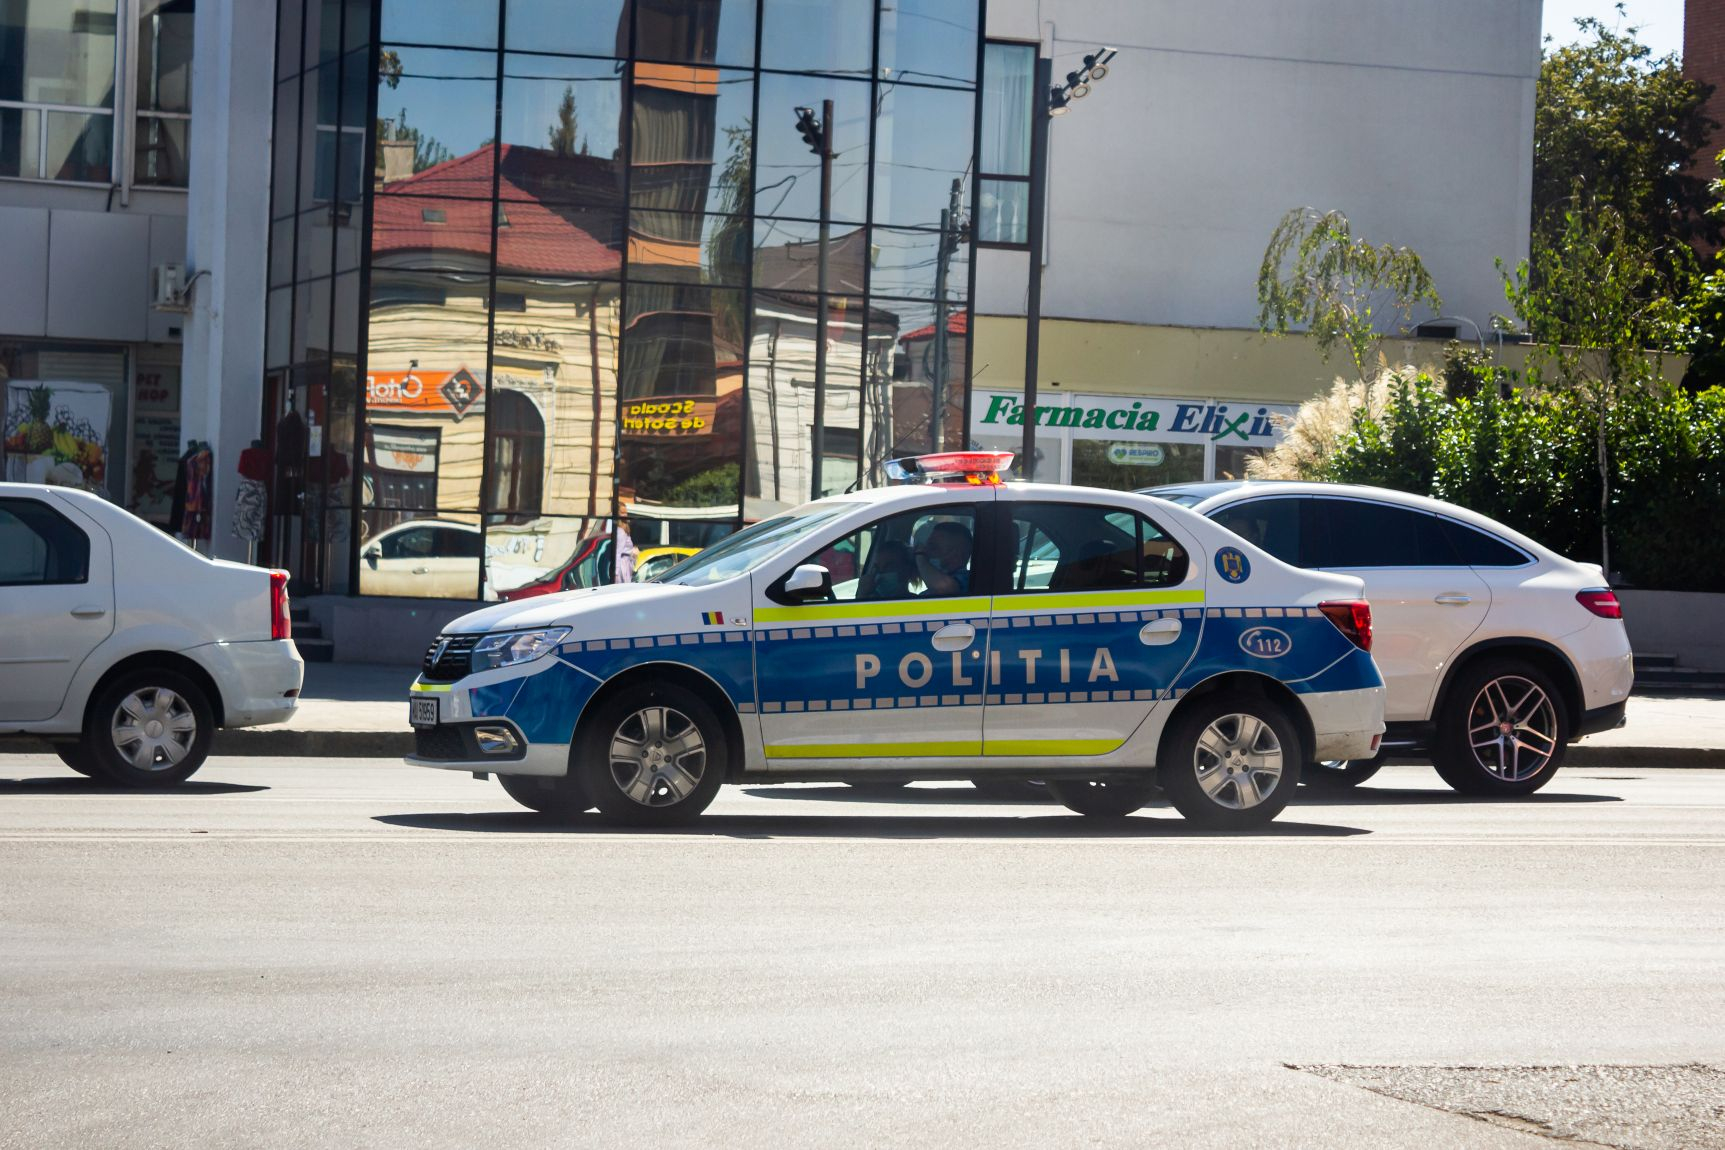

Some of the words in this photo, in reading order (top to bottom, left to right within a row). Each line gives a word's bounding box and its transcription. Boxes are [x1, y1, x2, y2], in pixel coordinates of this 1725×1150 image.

[980, 395, 1160, 431] Farmacia
[1167, 403, 1273, 441] Elixir
[1257, 638, 1281, 653] 112
[856, 647, 1119, 689] POLITIA
